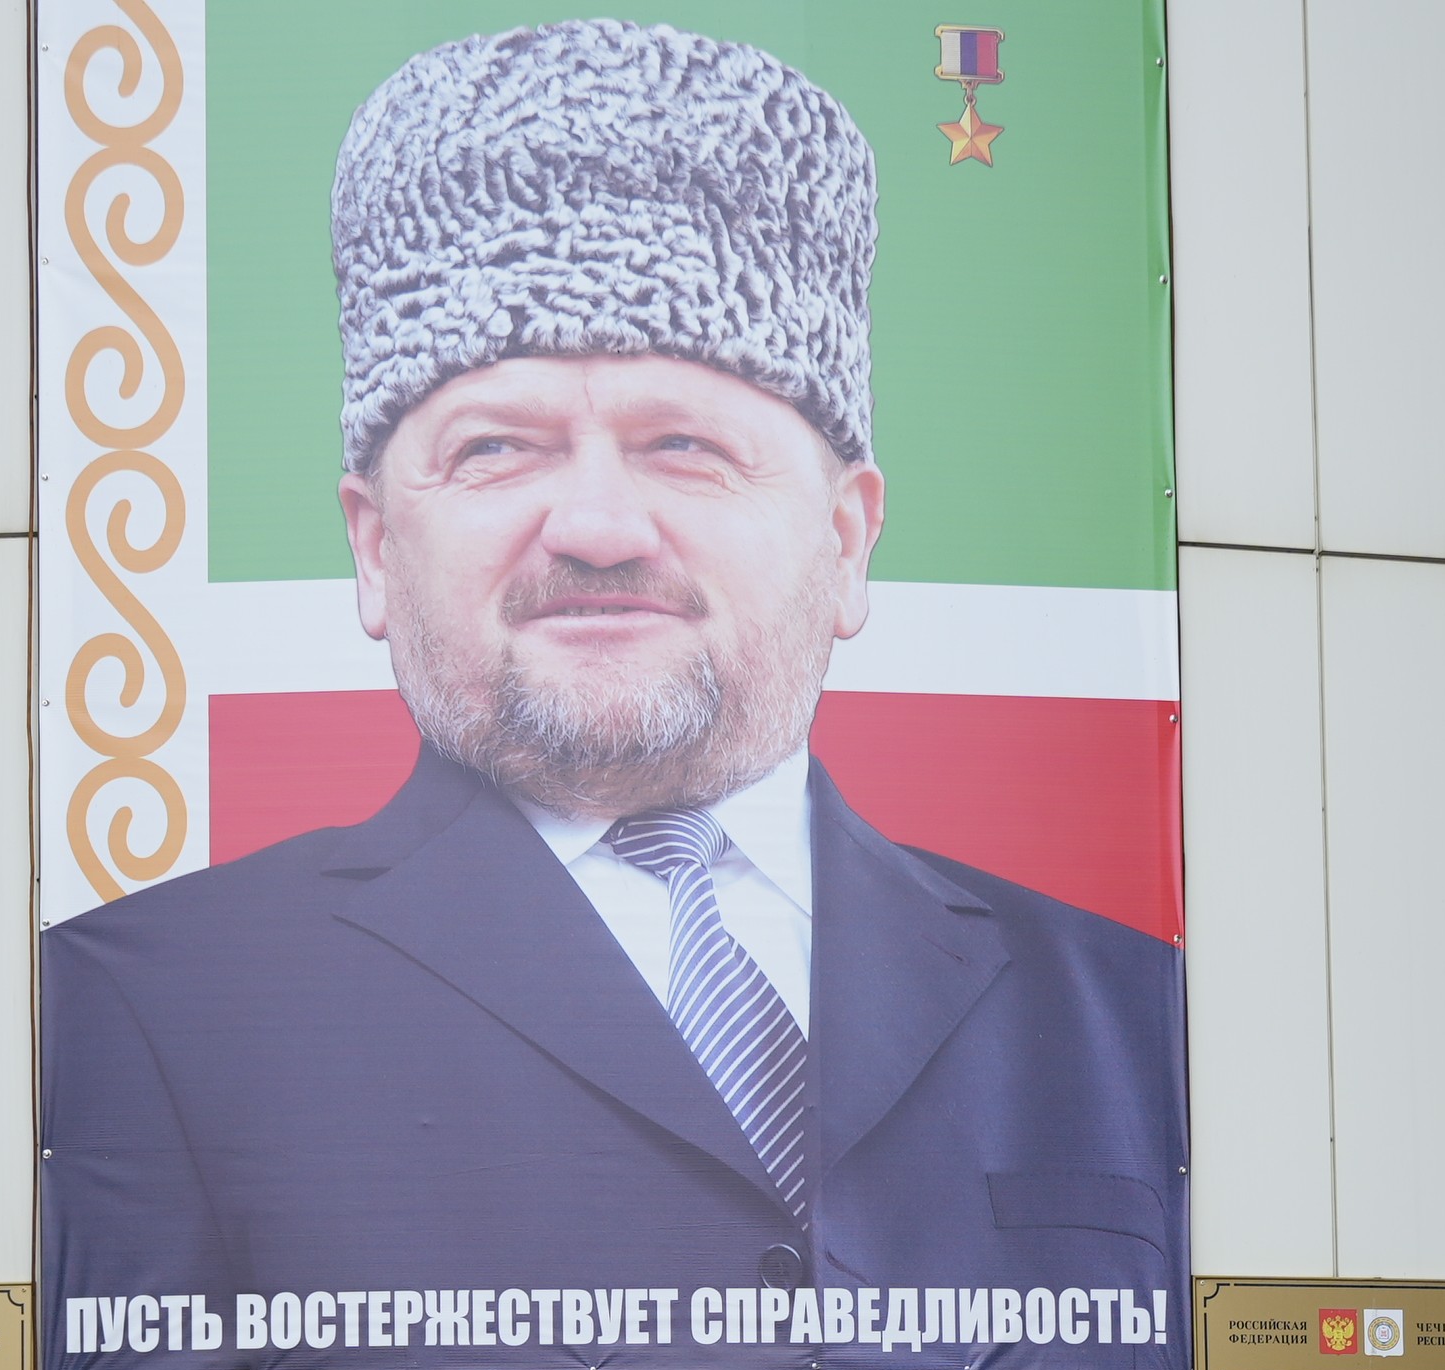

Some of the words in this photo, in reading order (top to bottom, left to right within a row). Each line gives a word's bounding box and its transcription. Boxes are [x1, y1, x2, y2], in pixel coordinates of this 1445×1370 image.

[66, 1294, 223, 1354] ПУСТЬ
[236, 1288, 679, 1350] ВОСТЕРЖЕСТВУЕТ
[690, 1284, 1167, 1353] СПРАВЕДЛИВОСТЬ!
[1229, 1318, 1307, 1331] РОССИЙСКАЯ
[1228, 1333, 1308, 1346] ФЕДЕРАЦИЯ
